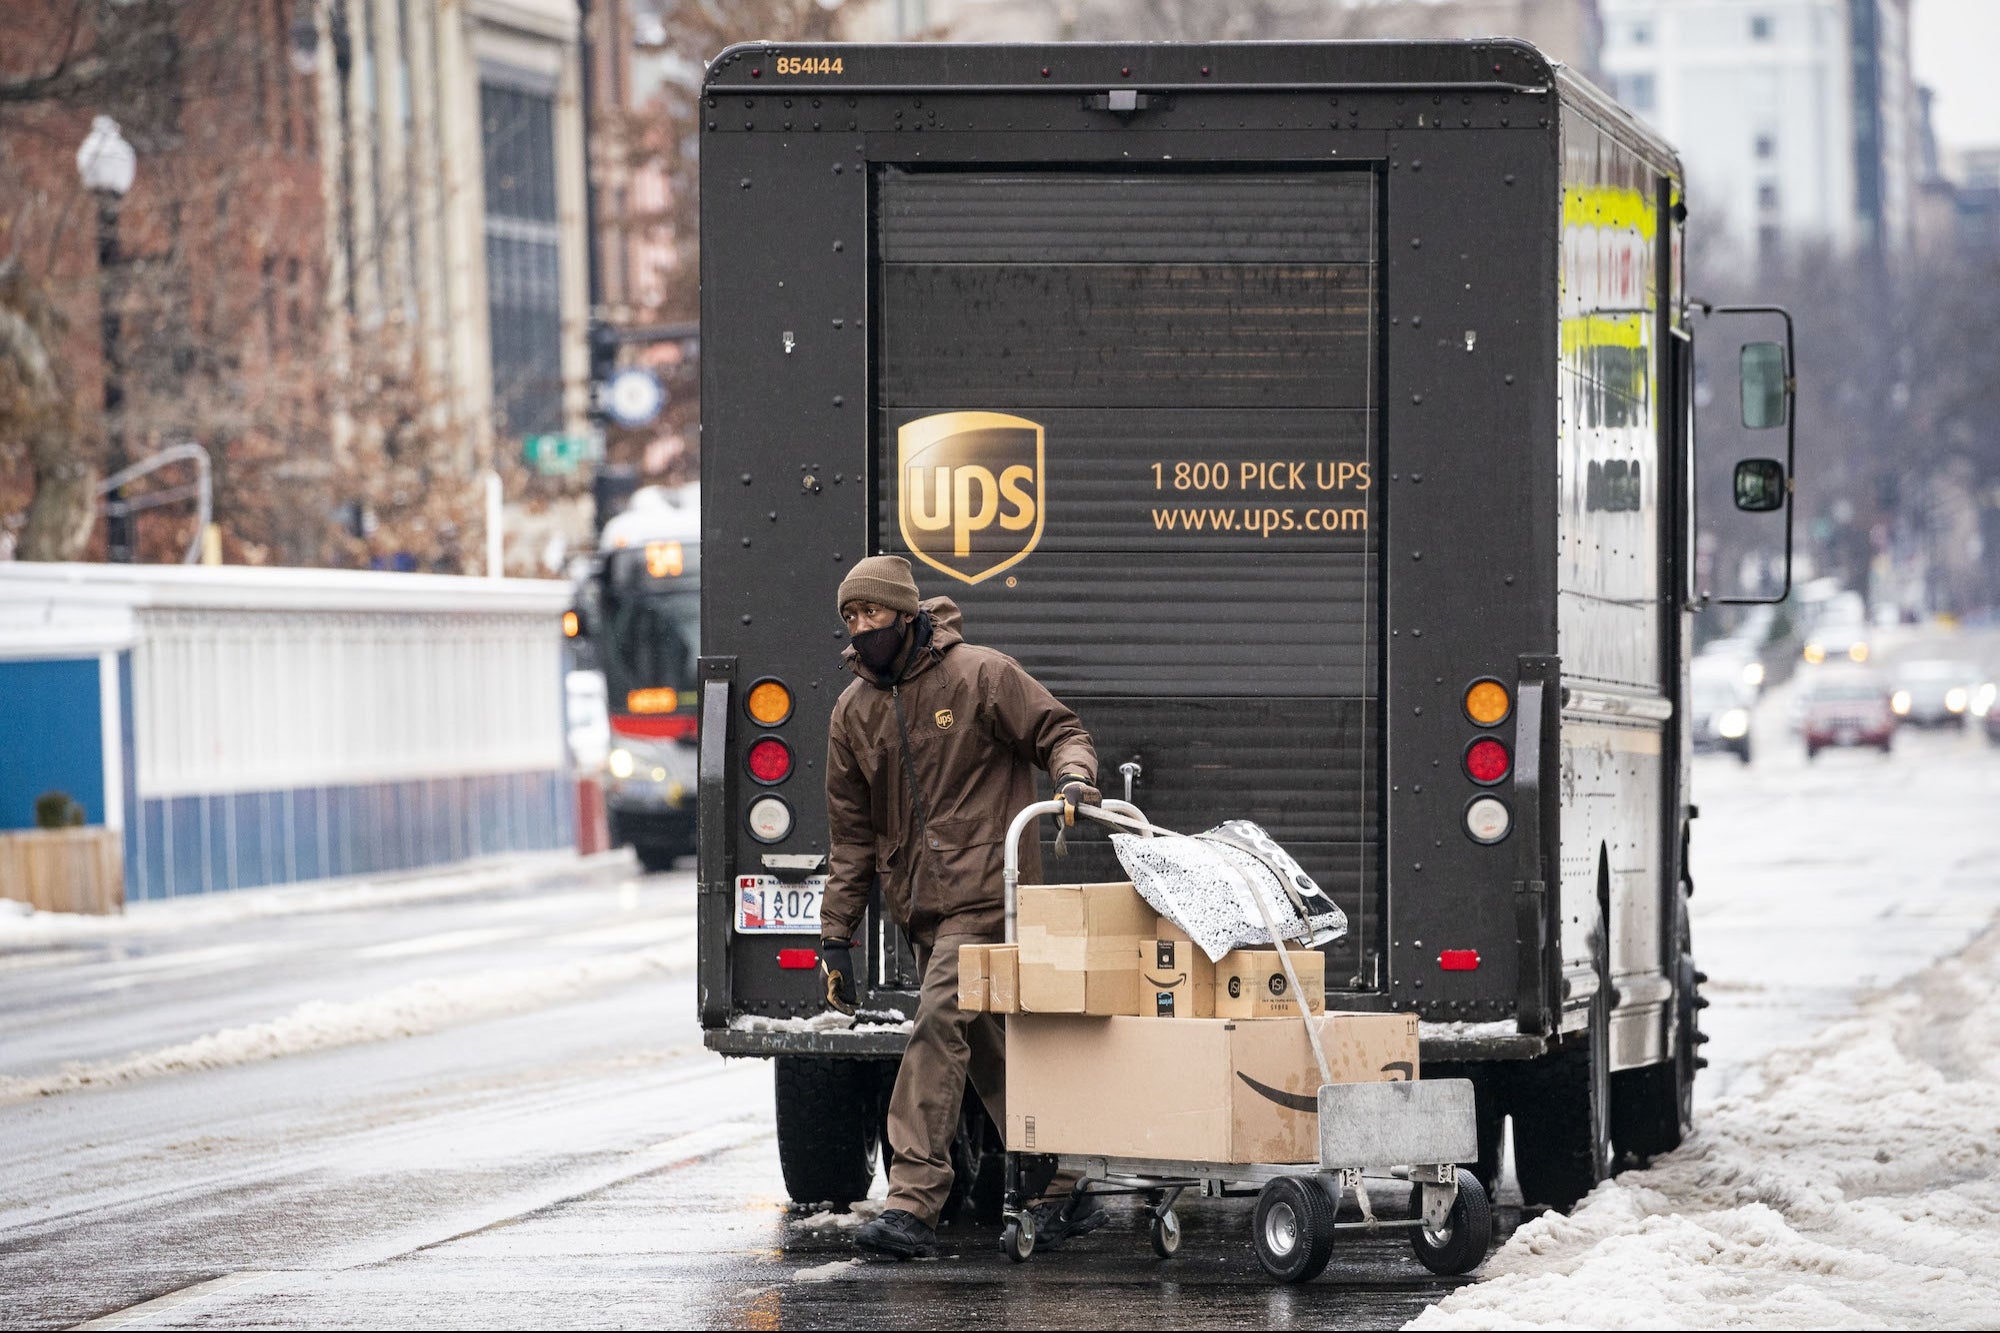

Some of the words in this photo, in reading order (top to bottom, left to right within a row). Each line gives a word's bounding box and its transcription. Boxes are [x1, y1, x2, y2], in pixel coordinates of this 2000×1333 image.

[776, 57, 844, 75] 854144
[1151, 462, 1162, 490] 1
[1174, 462, 1230, 490] 800
[1240, 462, 1307, 490] PICK
[1316, 462, 1372, 490] UPS
[910, 464, 1036, 557] ups
[1151, 508, 1368, 538] www.ups.com
[937, 714, 952, 726] ups
